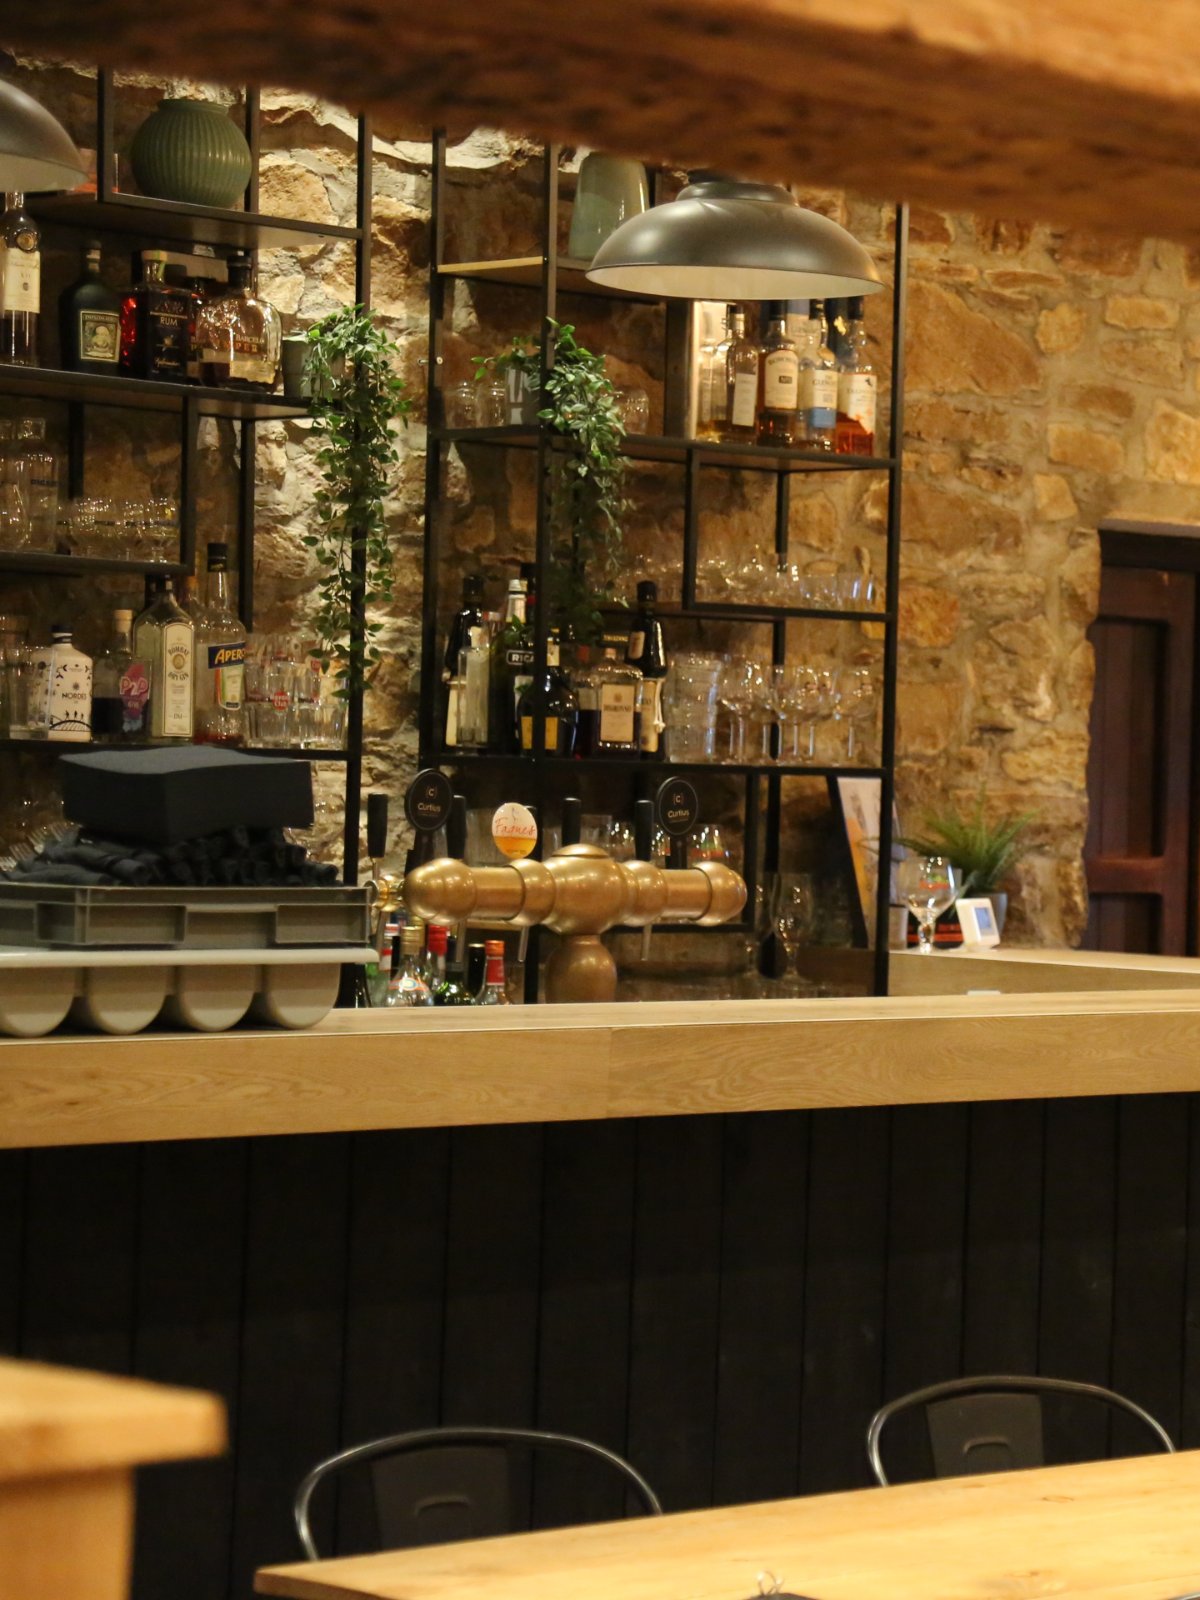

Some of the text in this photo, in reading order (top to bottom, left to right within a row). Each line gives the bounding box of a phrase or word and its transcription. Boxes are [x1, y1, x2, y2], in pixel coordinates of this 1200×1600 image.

[160, 316, 178, 326] RUM
[417, 802, 441, 813] Curtius
[667, 810, 690, 818] Curtius
